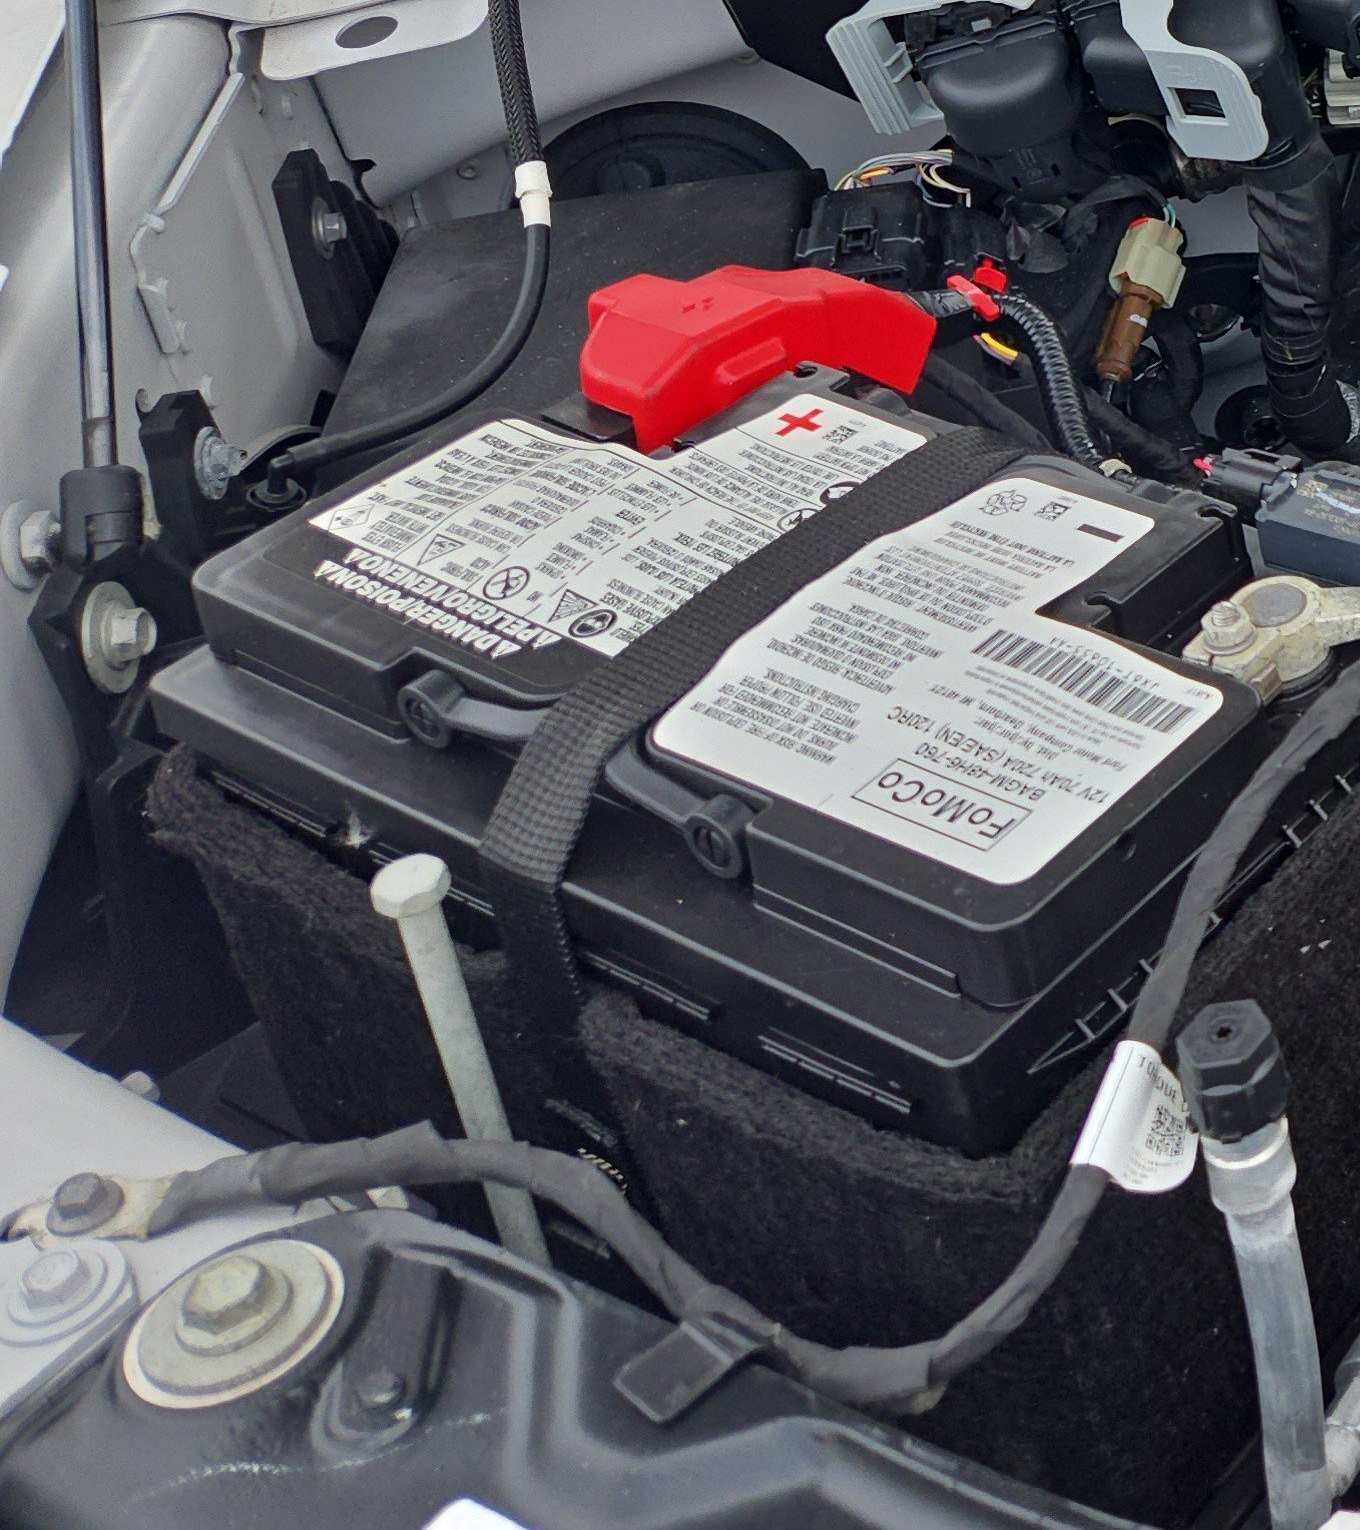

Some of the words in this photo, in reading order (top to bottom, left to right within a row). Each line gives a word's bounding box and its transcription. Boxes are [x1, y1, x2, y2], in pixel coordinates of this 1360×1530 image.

[327, 565, 512, 650] DANGER/POISON
[345, 555, 554, 641] PELIGRO/VENENO
[878, 772, 1016, 839] FoMoCo
[1076, 787, 1108, 803] 12V
